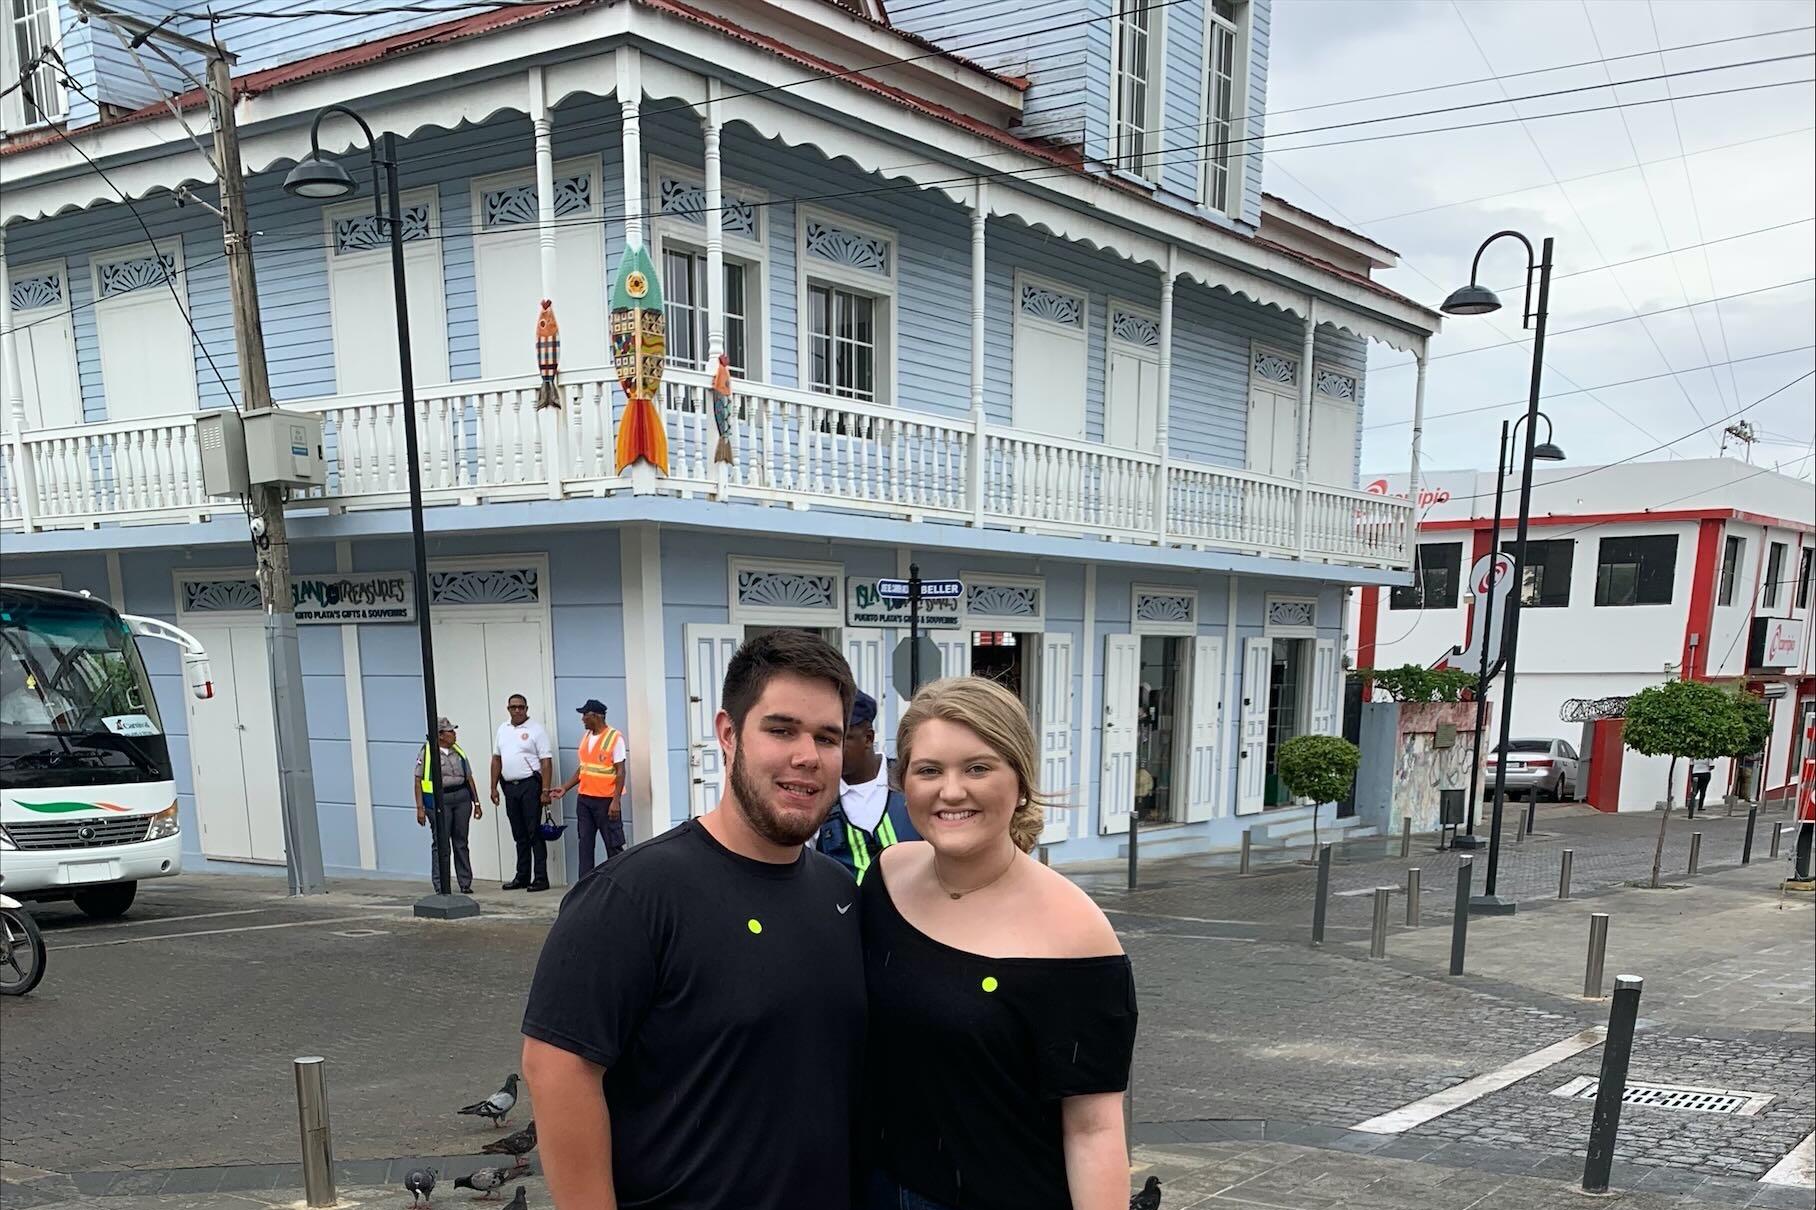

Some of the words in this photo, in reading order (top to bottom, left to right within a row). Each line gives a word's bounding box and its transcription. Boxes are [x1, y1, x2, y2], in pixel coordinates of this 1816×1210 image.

[291, 580, 328, 608] SLAND
[336, 578, 404, 605] TREASURES
[921, 584, 959, 594] BELLER
